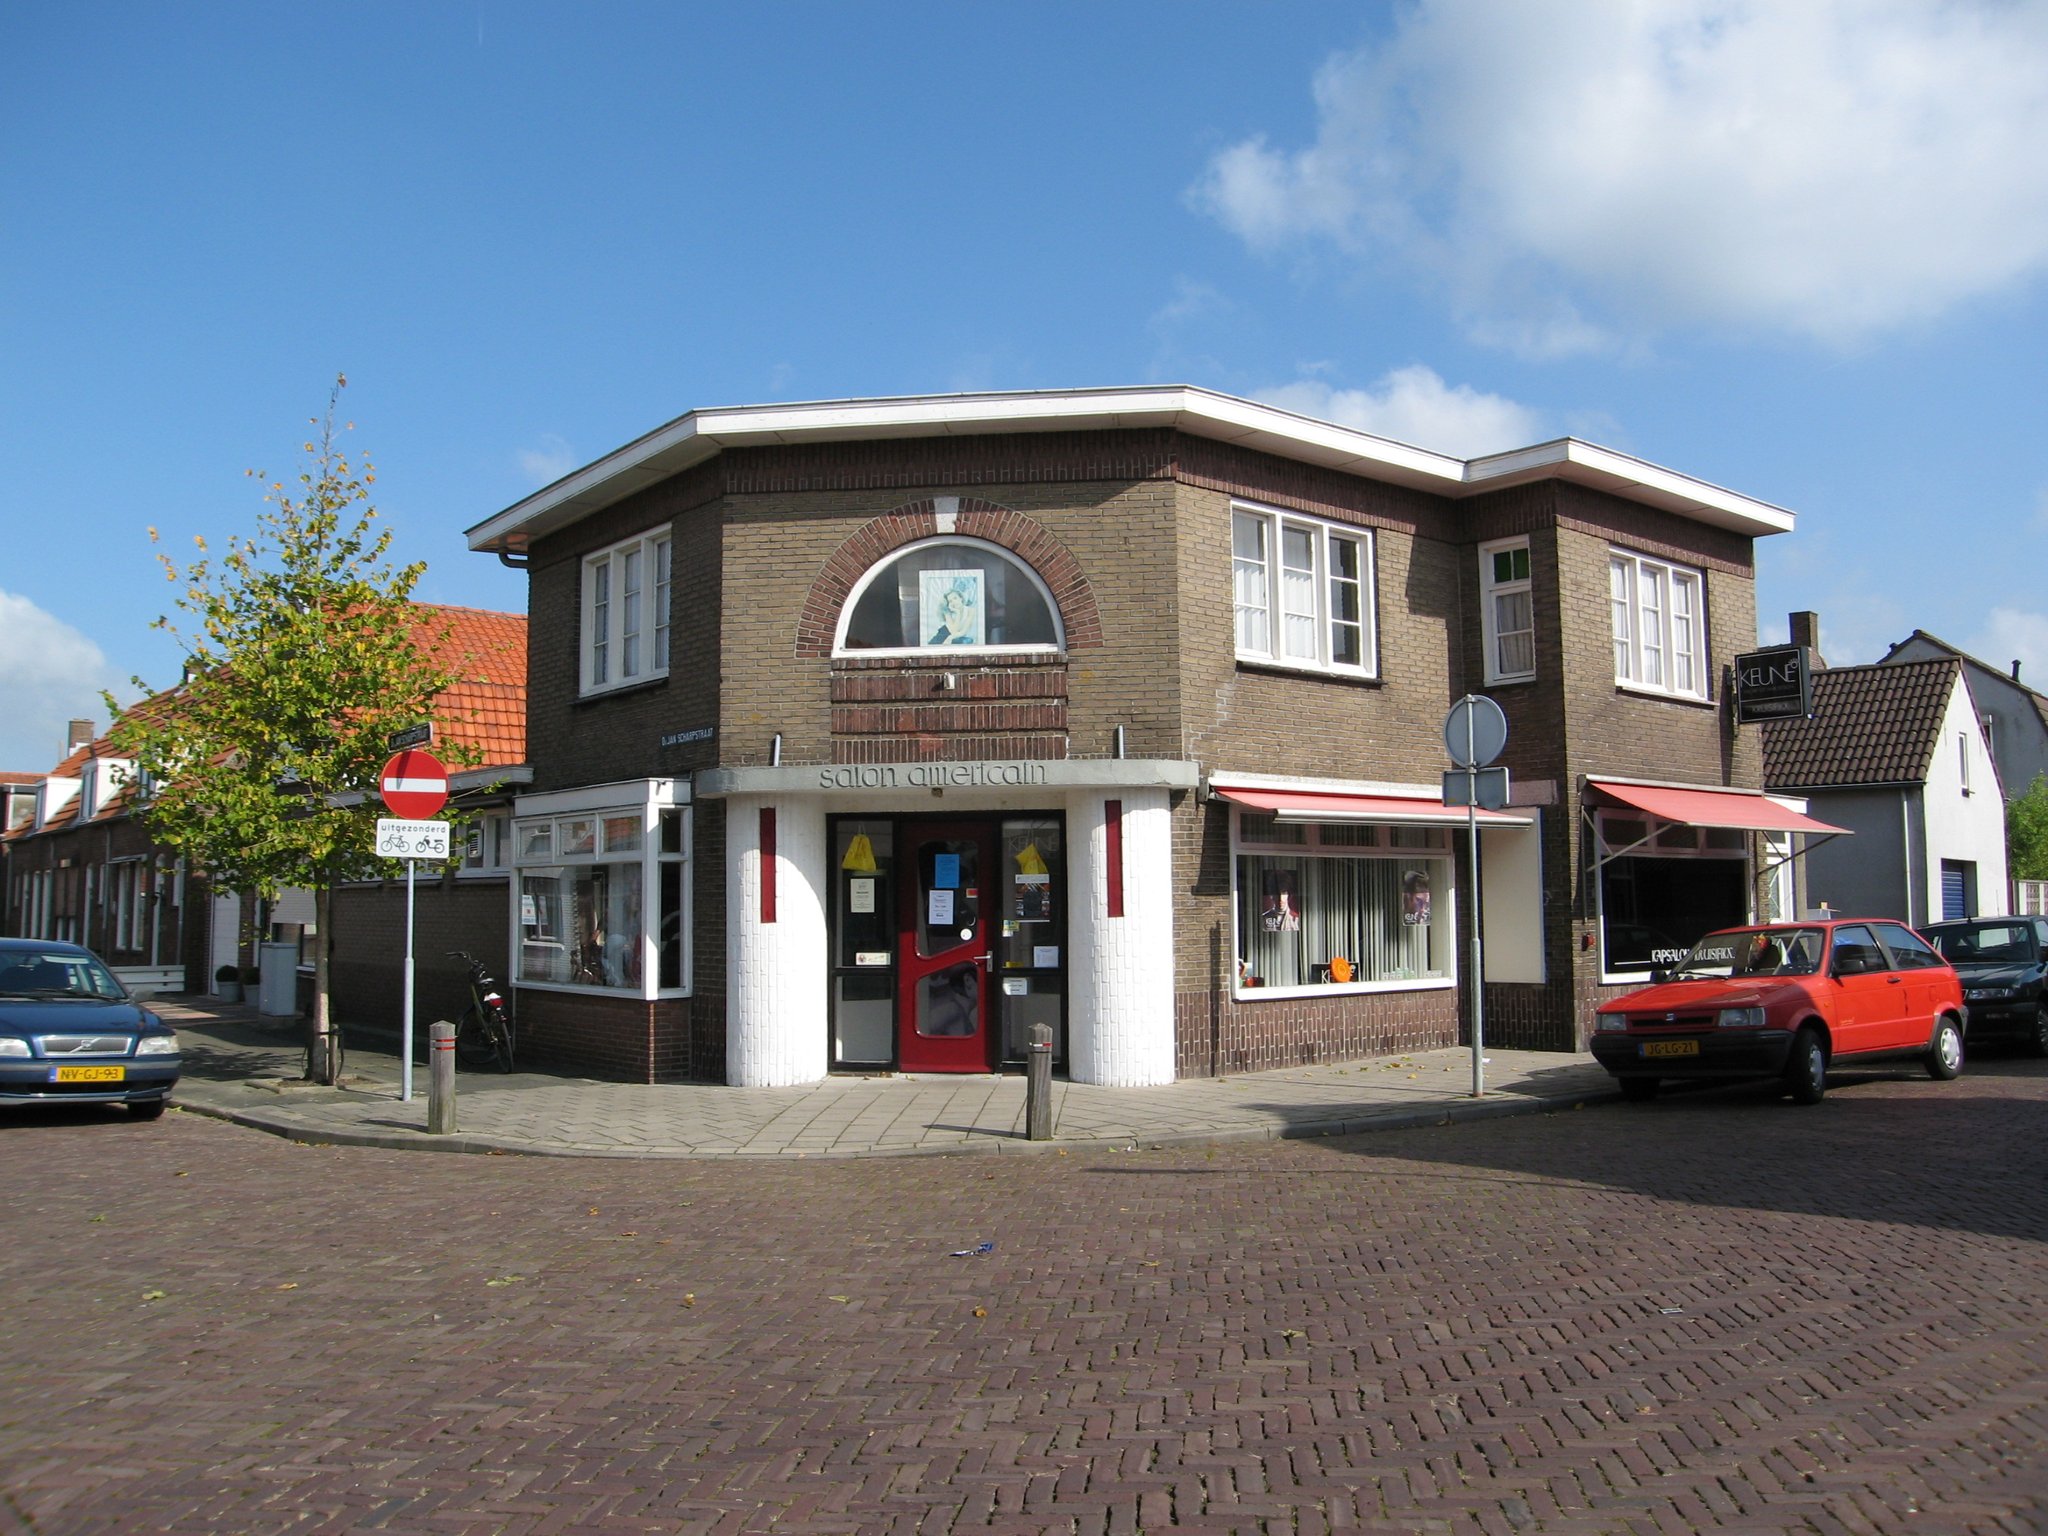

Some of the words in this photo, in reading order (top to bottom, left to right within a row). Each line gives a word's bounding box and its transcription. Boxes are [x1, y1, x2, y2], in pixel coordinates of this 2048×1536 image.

[1740, 664, 1796, 688] KEUNE
[820, 766, 899, 789] salon
[908, 761, 1049, 787] americain
[381, 824, 446, 833] uitgezonderd
[1649, 1042, 1693, 1055] JG-LG-21
[60, 1068, 119, 1080] NV-GJ-93
